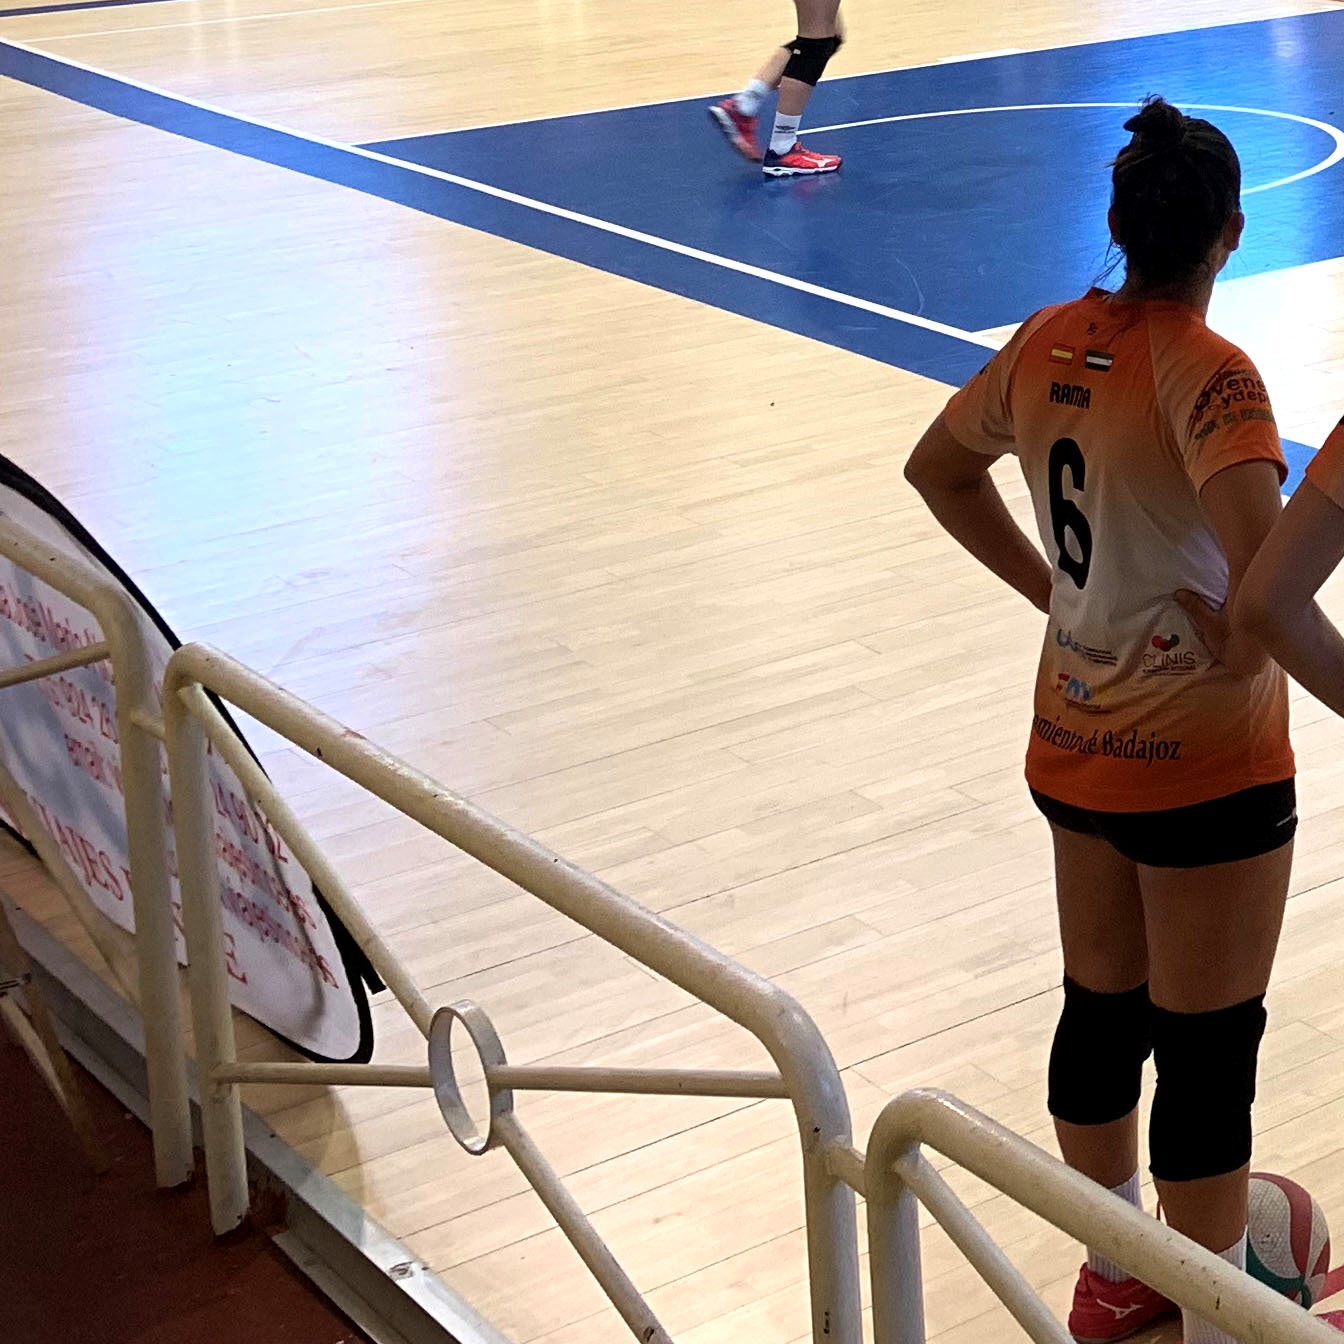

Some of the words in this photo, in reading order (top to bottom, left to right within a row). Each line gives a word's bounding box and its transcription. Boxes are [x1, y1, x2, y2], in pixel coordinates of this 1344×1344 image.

[1050, 381, 1091, 409] RAMA
[1048, 437, 1093, 590] 6
[1142, 651, 1197, 668] CLINIS
[1103, 730, 1184, 767] Badajoz
